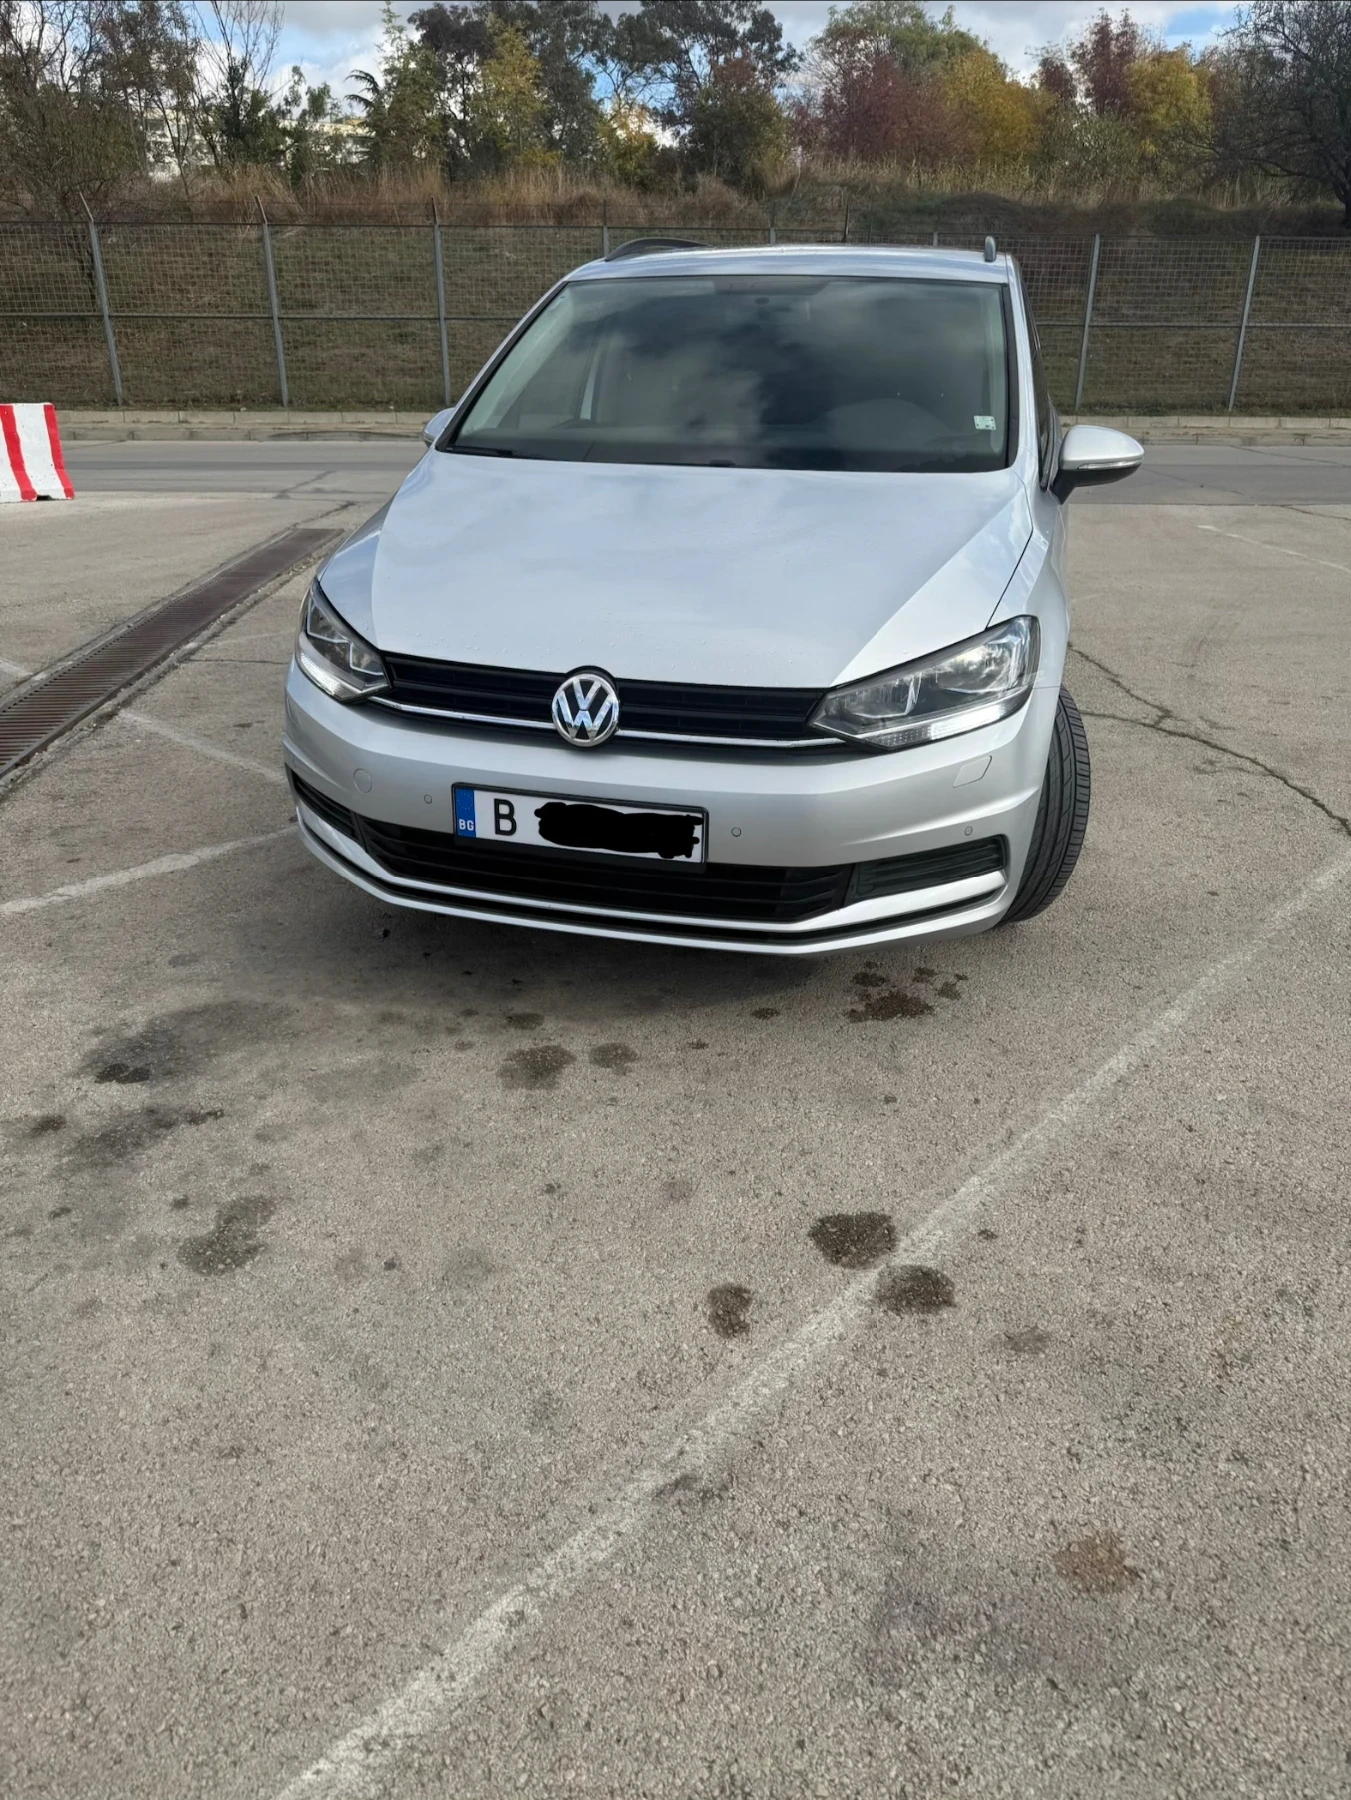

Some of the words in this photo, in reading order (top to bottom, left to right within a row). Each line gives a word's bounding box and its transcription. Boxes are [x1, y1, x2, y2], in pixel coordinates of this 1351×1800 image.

[554, 675, 617, 745] VW
[459, 818, 475, 831] BG
[494, 798, 517, 836] B
